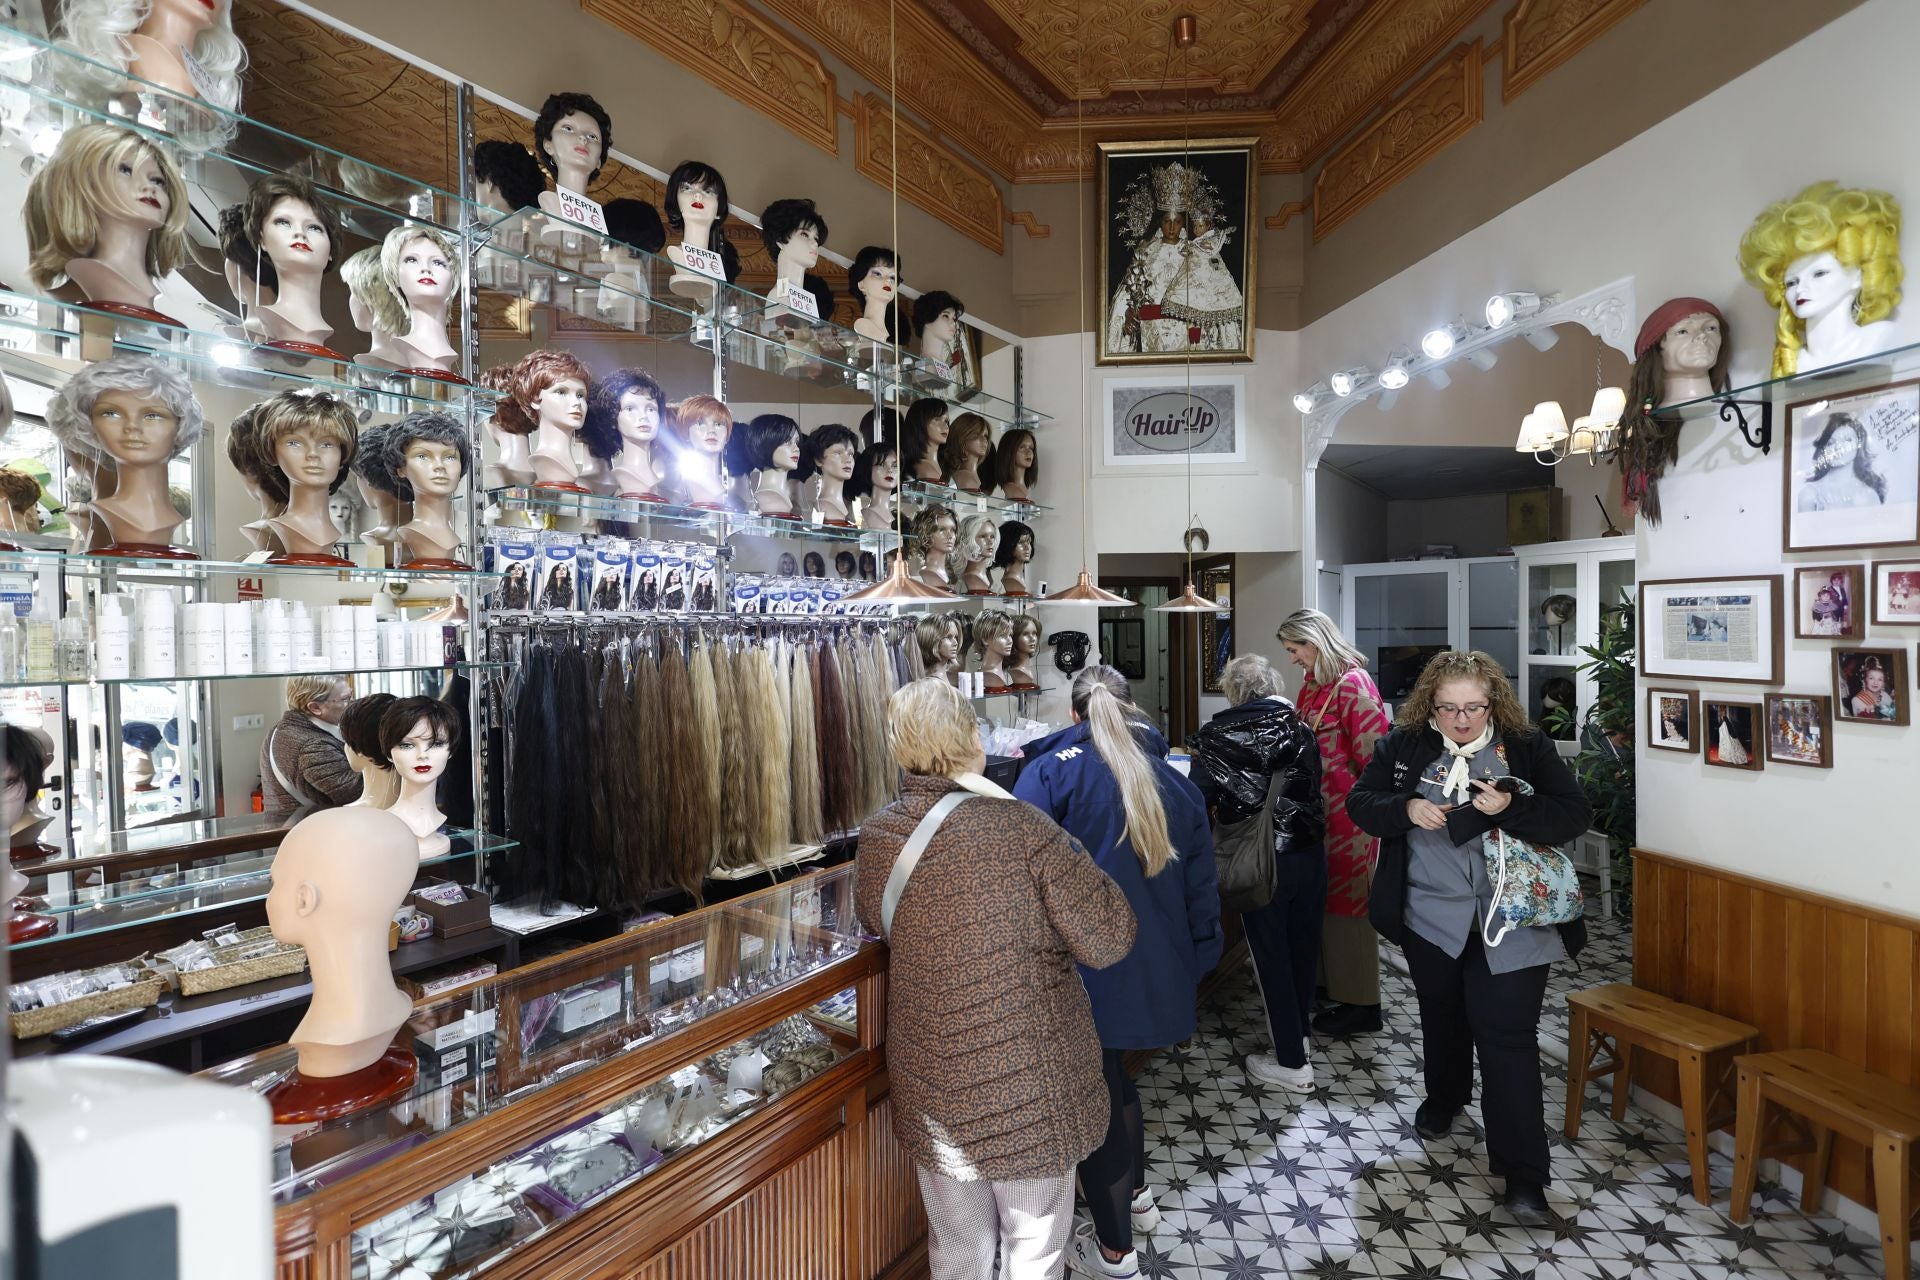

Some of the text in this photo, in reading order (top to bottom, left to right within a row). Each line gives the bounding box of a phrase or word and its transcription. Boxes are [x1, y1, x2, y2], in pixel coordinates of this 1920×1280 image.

[561, 193, 600, 216] OFERTA
[562, 203, 603, 231] 90 €
[684, 245, 718, 261] OFERTA
[686, 254, 721, 275] 90 €
[789, 288, 814, 304] OFERTA
[792, 298, 804, 310] 90
[443, 888, 456, 898] CAP
